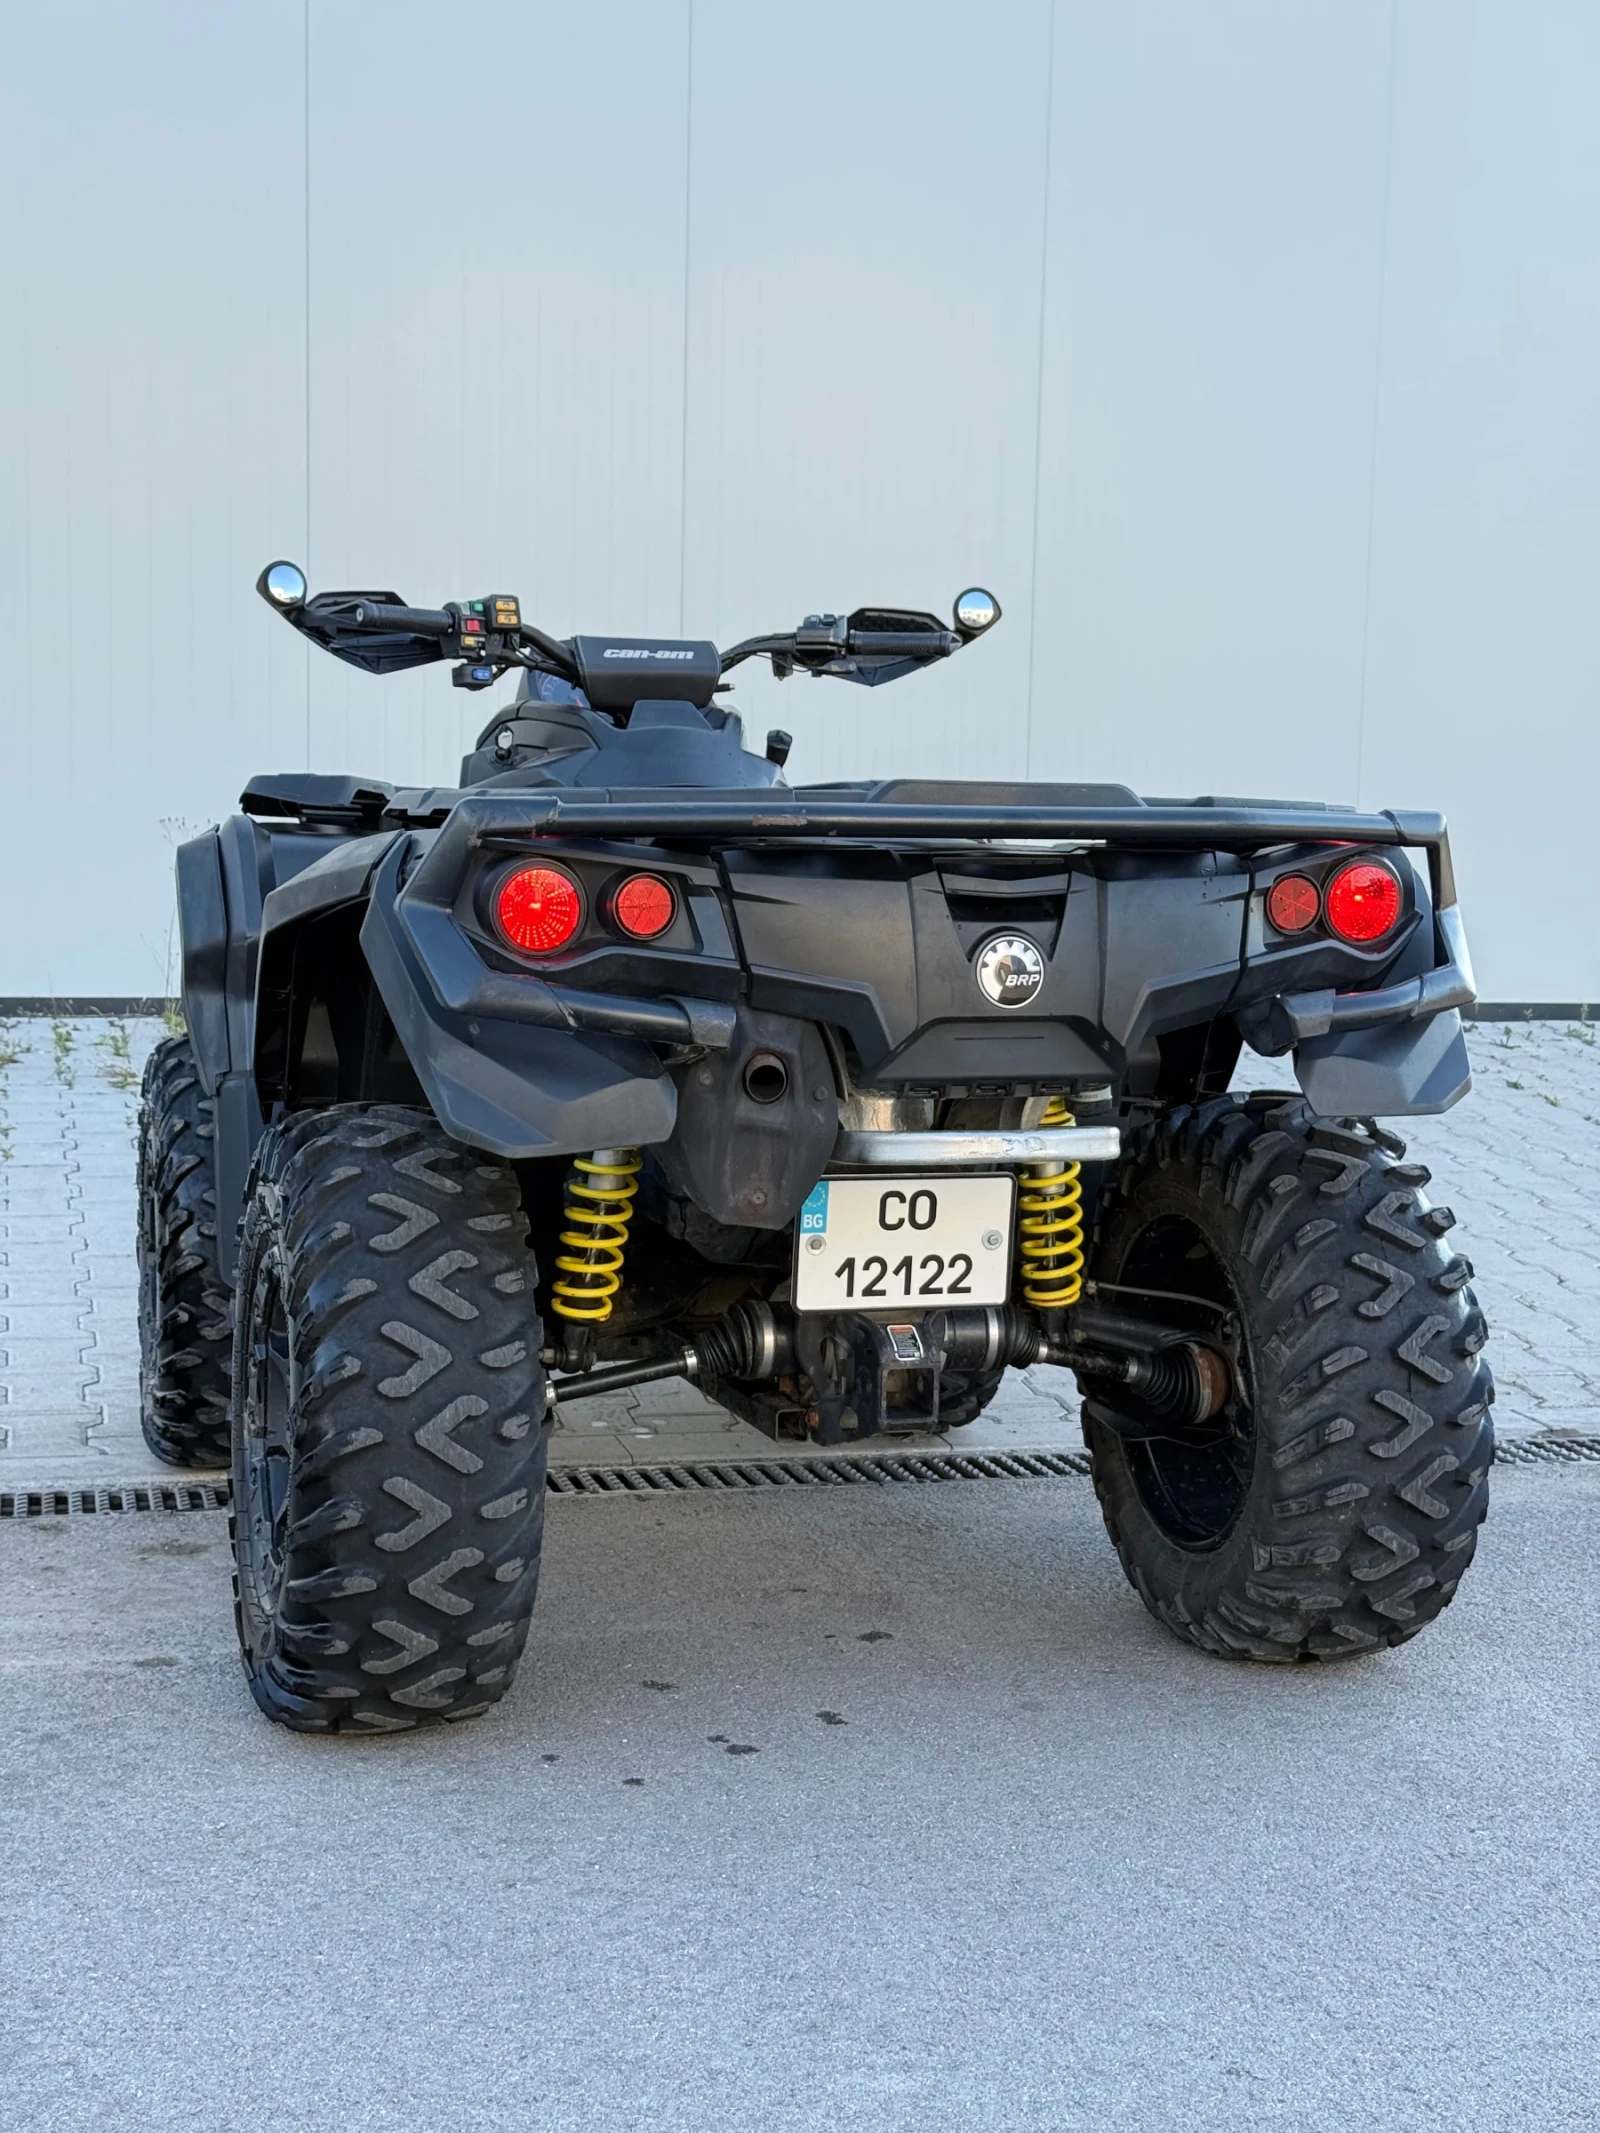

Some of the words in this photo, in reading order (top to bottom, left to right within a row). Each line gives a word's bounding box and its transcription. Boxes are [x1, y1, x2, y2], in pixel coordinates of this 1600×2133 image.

[603, 648, 694, 660] can-am
[1005, 974, 1040, 987] BRP
[879, 1189, 938, 1231] CO
[803, 1213, 824, 1229] BG
[834, 1253, 973, 1298] 12122
